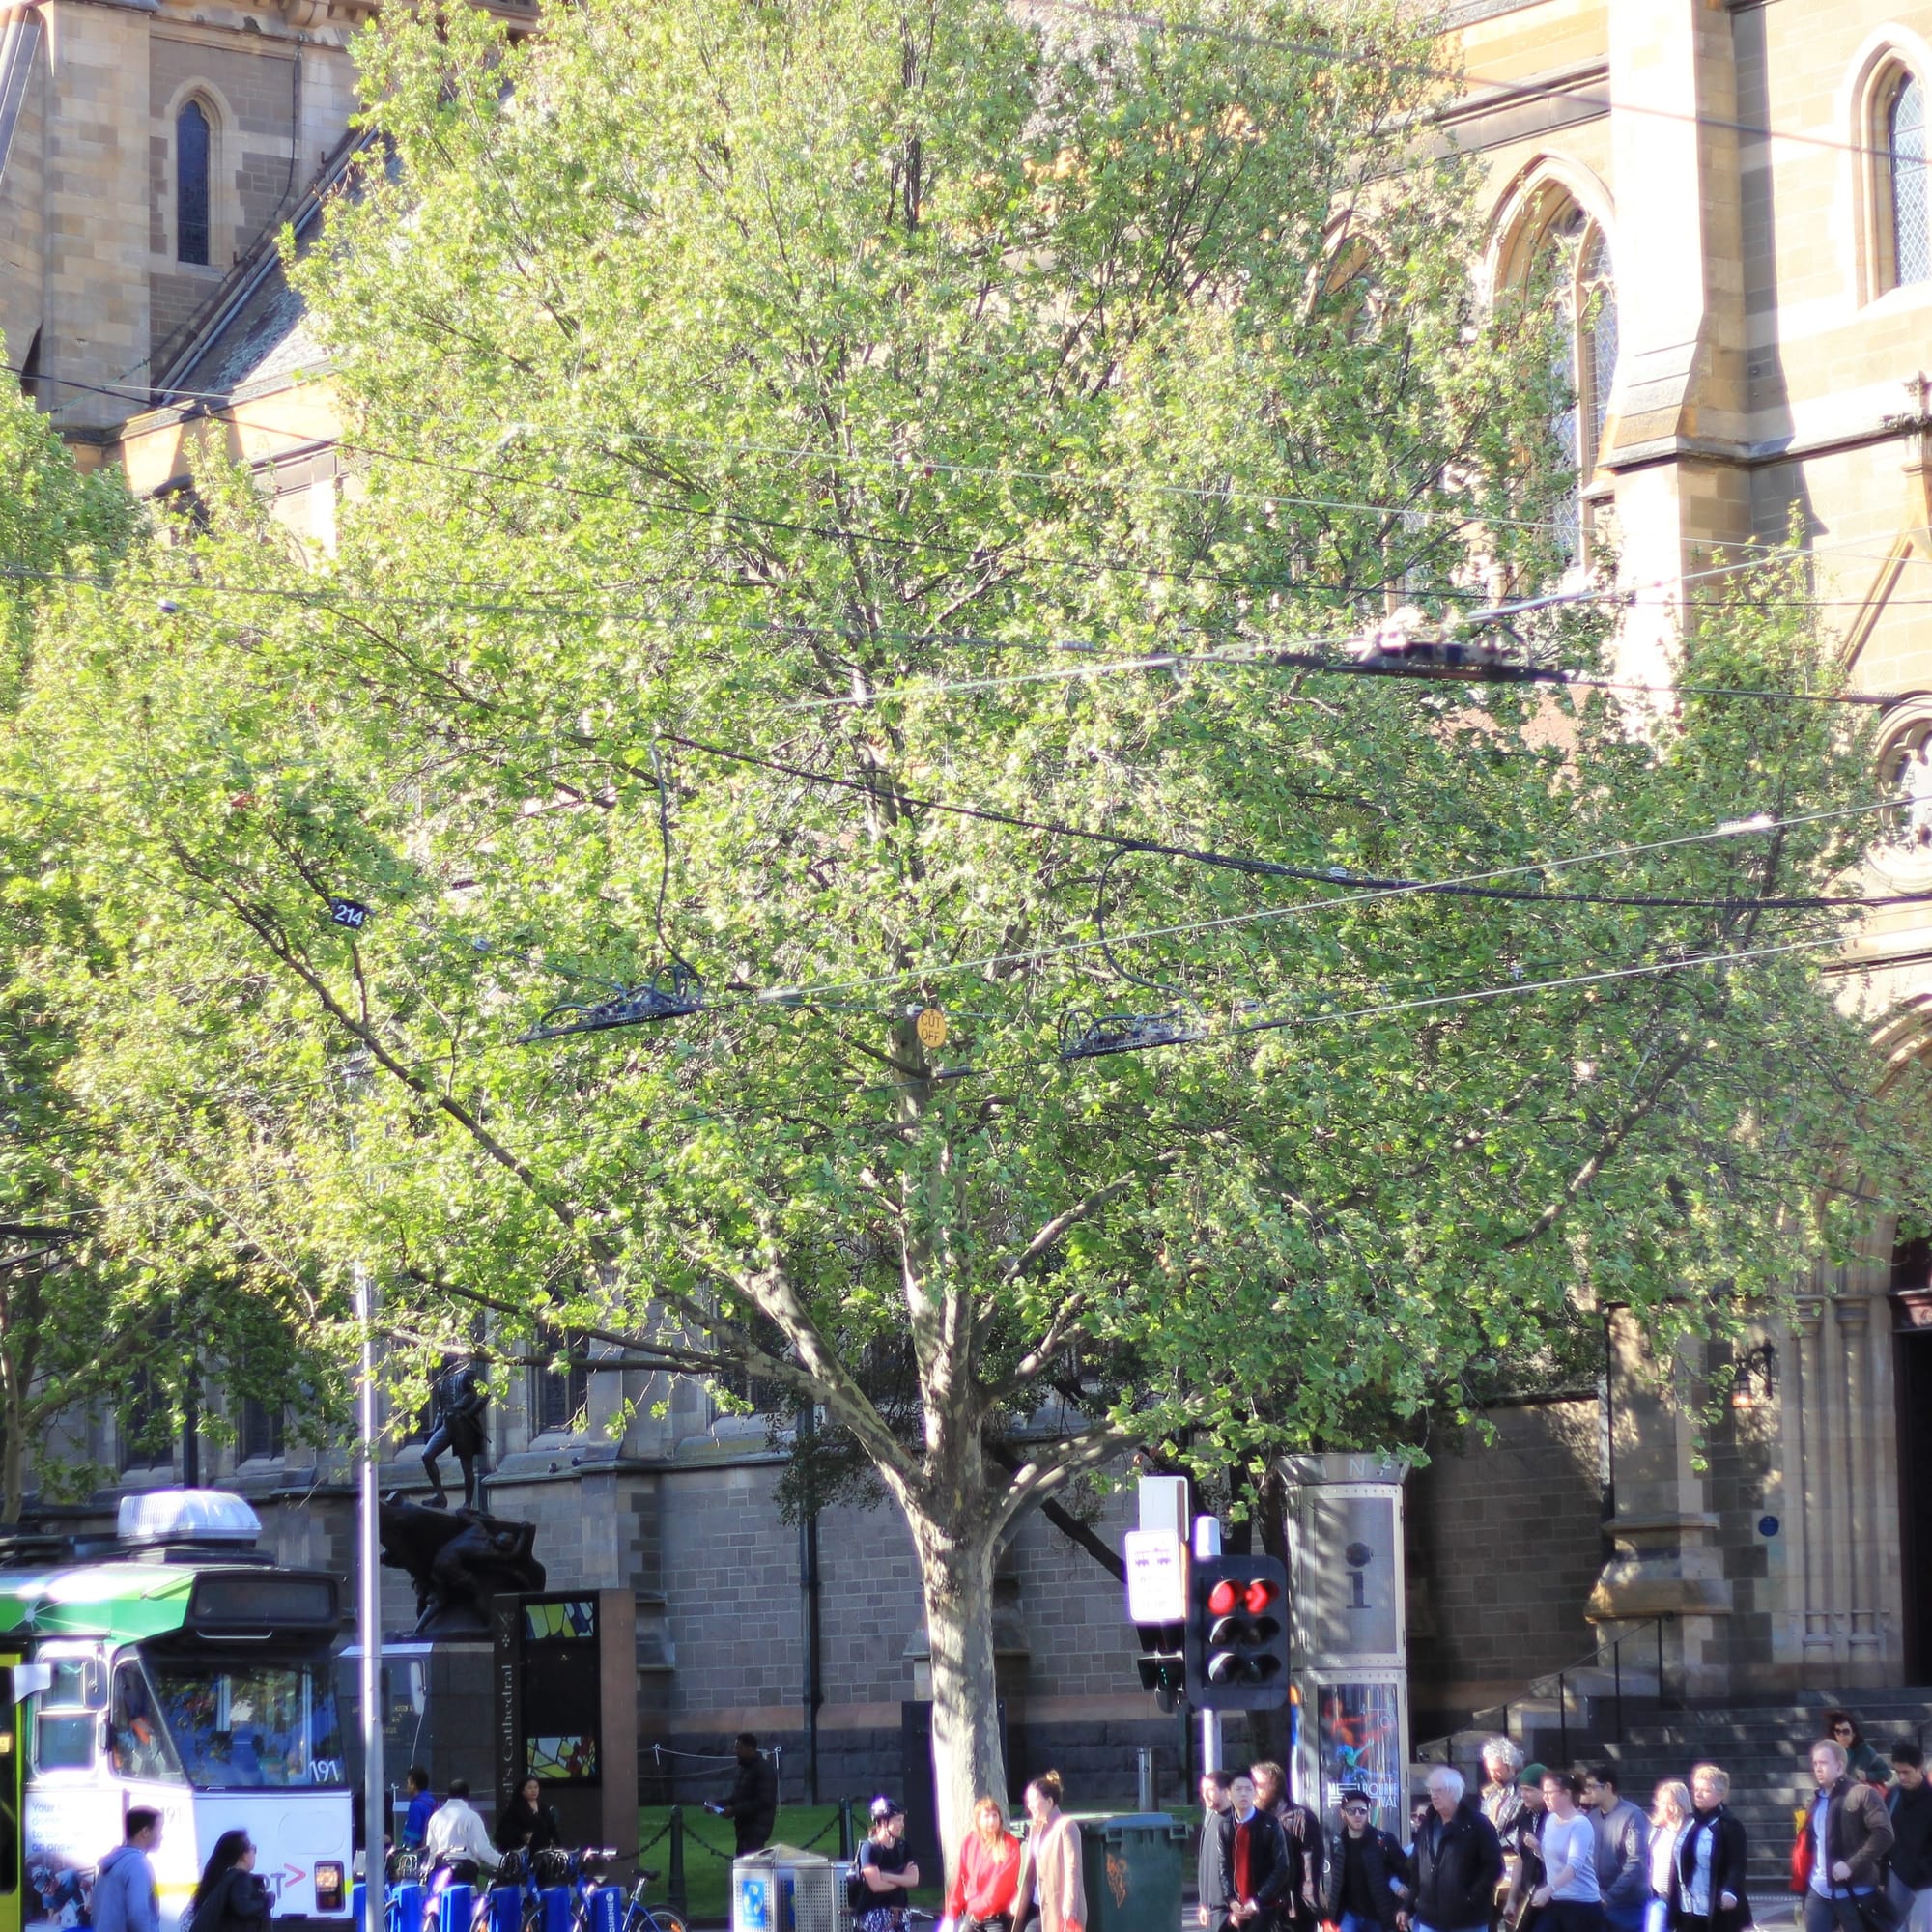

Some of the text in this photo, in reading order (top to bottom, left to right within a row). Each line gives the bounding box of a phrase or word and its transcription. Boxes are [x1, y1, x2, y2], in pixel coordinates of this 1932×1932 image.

[334, 904, 364, 925] 214
[922, 1013, 940, 1029] CUT
[922, 1029, 940, 1042] OFF
[501, 1664, 513, 1762] Cathedral
[310, 1760, 340, 1782] 191
[32, 1802, 55, 1813] Your
